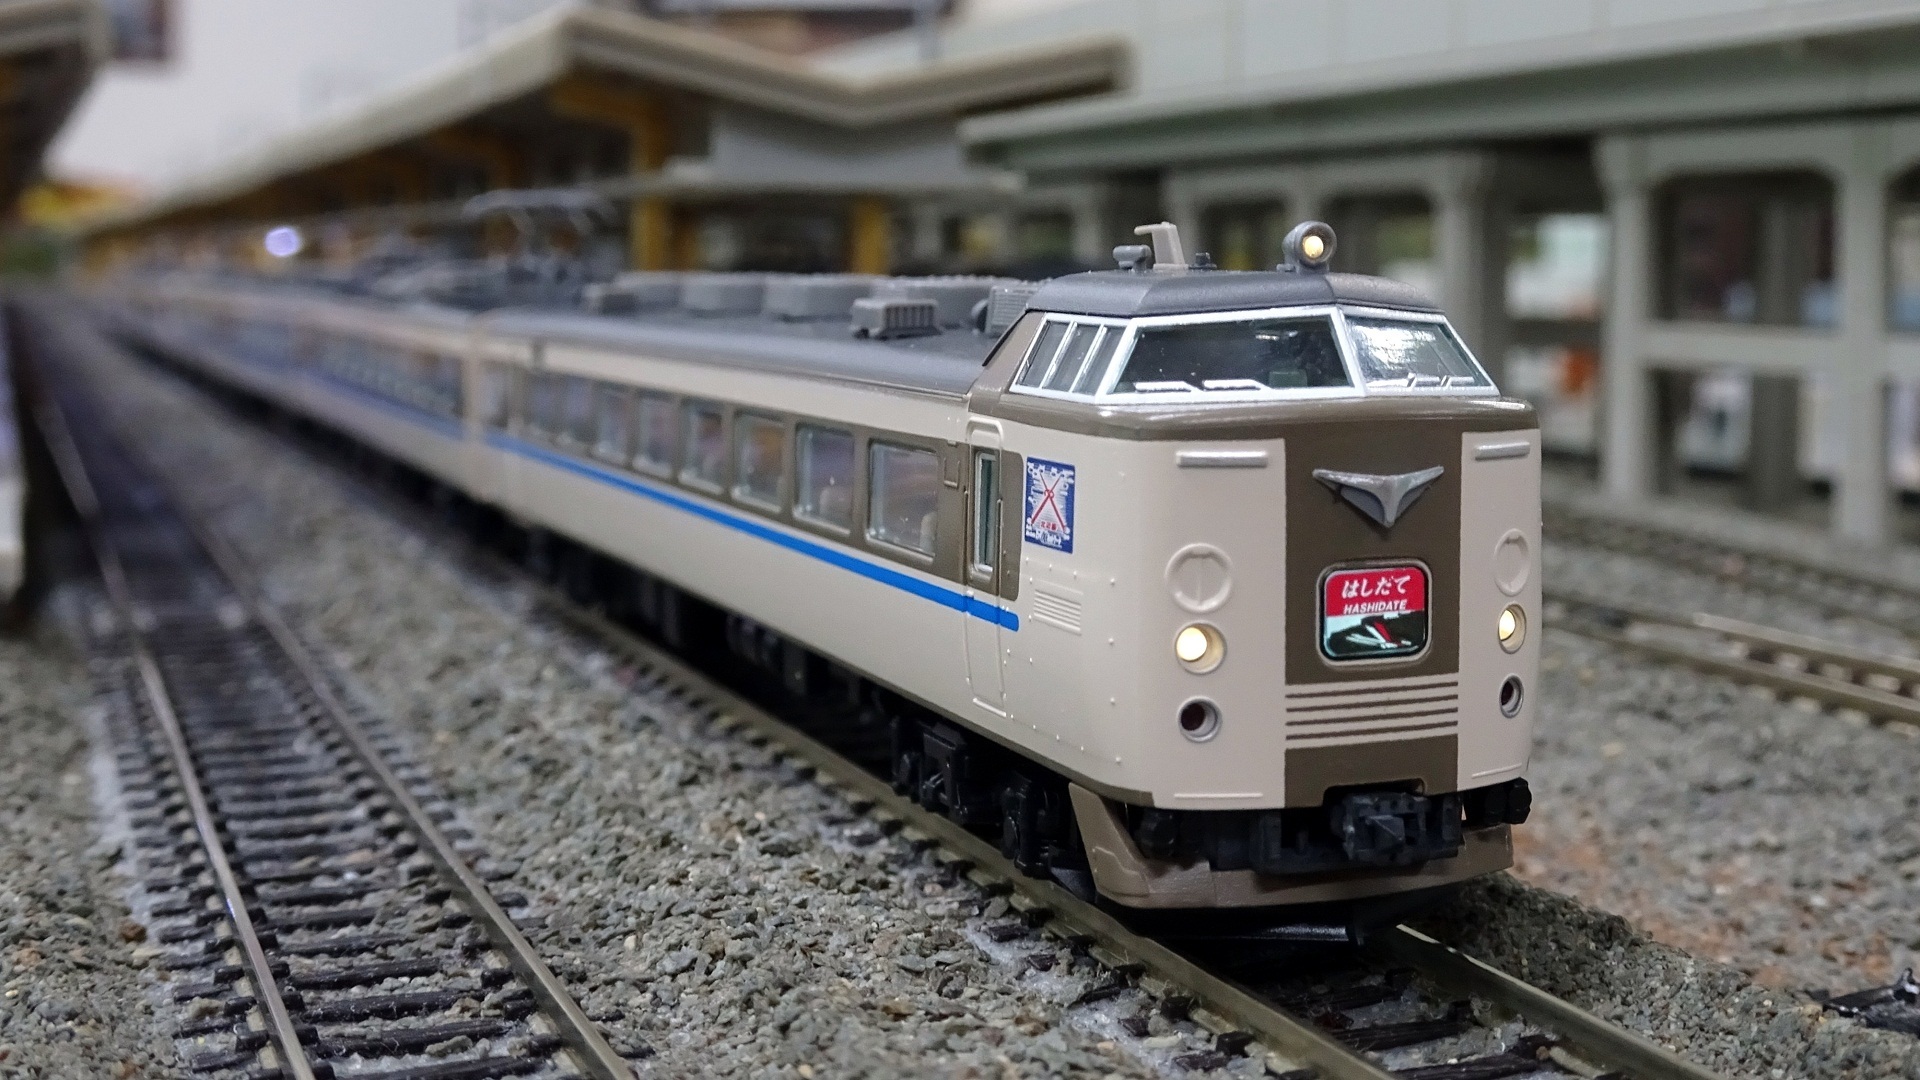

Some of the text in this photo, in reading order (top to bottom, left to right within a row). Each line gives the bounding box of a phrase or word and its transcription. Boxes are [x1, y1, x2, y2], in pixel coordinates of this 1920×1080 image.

[1341, 575, 1411, 599] はしだて
[1343, 599, 1408, 615] HASHIDATE
